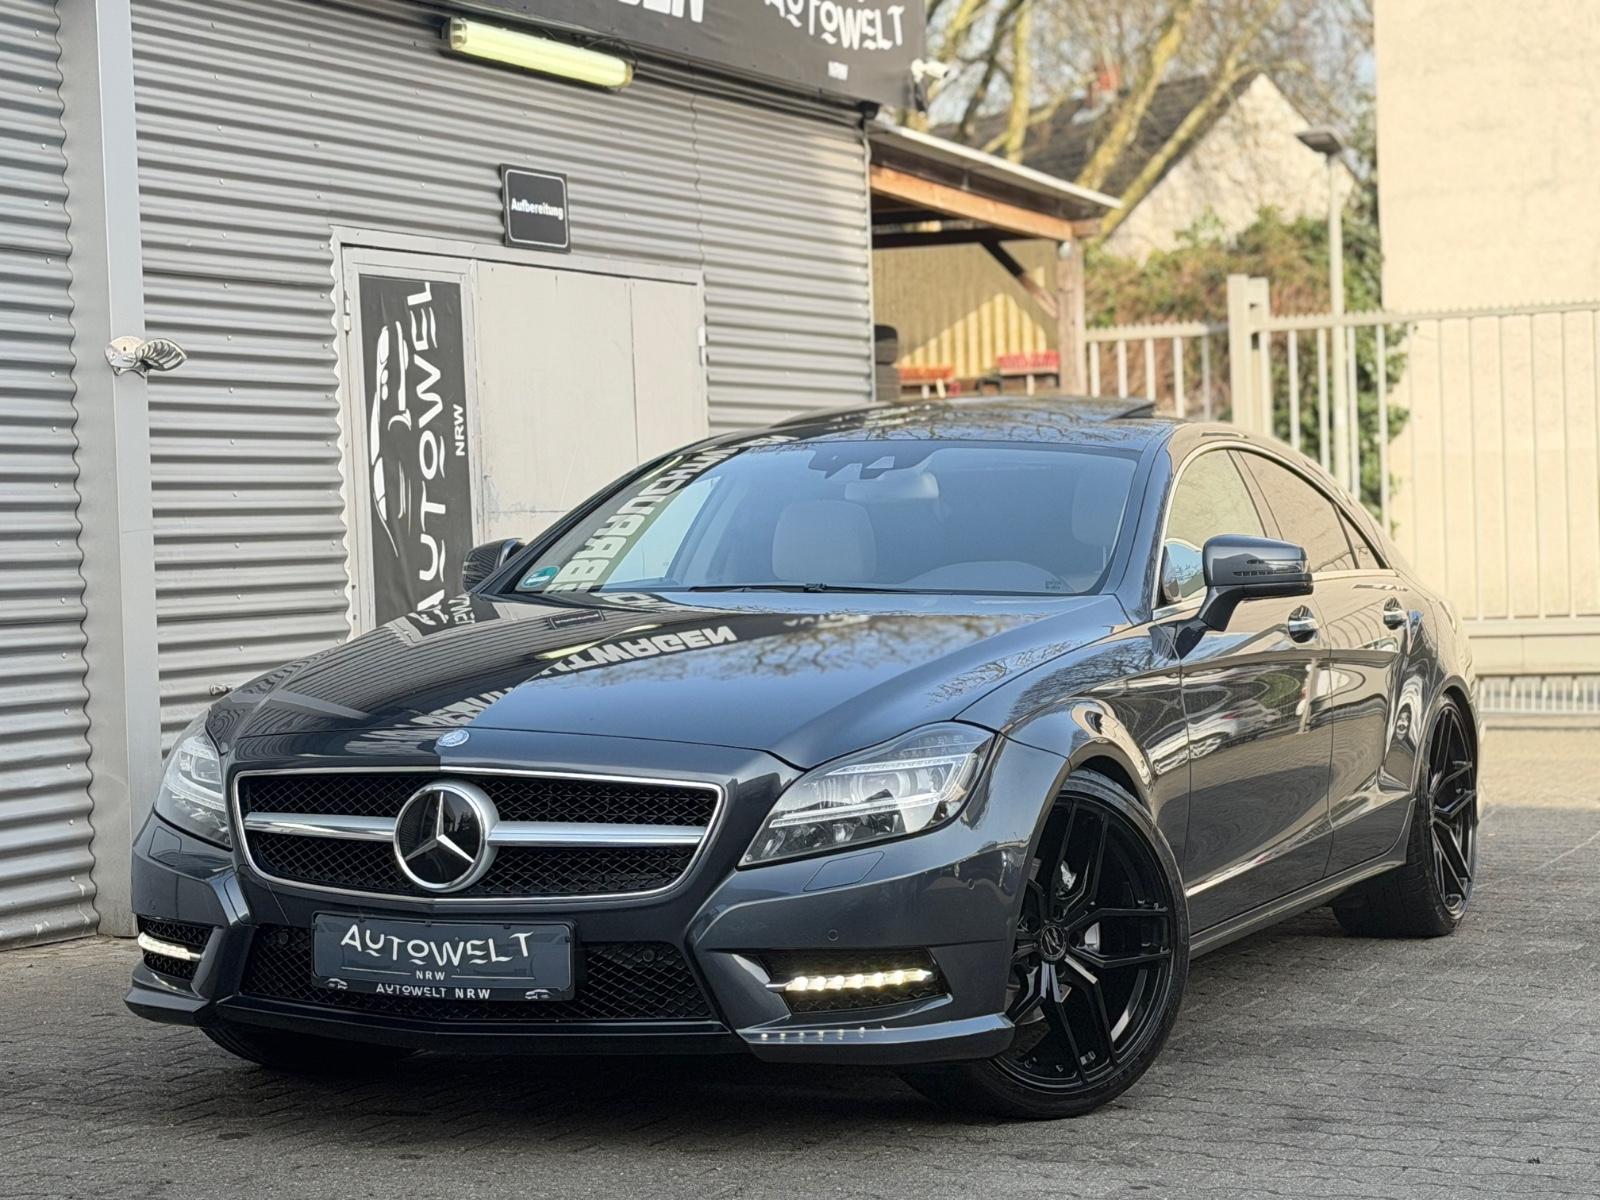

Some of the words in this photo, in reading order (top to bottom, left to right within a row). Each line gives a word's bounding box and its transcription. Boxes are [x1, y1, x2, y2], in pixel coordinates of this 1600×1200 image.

[511, 197, 564, 221] Aufbereitung
[453, 404, 467, 456] NRW
[341, 924, 534, 967] AUTOWELT
[415, 970, 446, 981] NRW
[375, 983, 448, 999] AUTOWELT
[455, 988, 491, 1000] NRW
